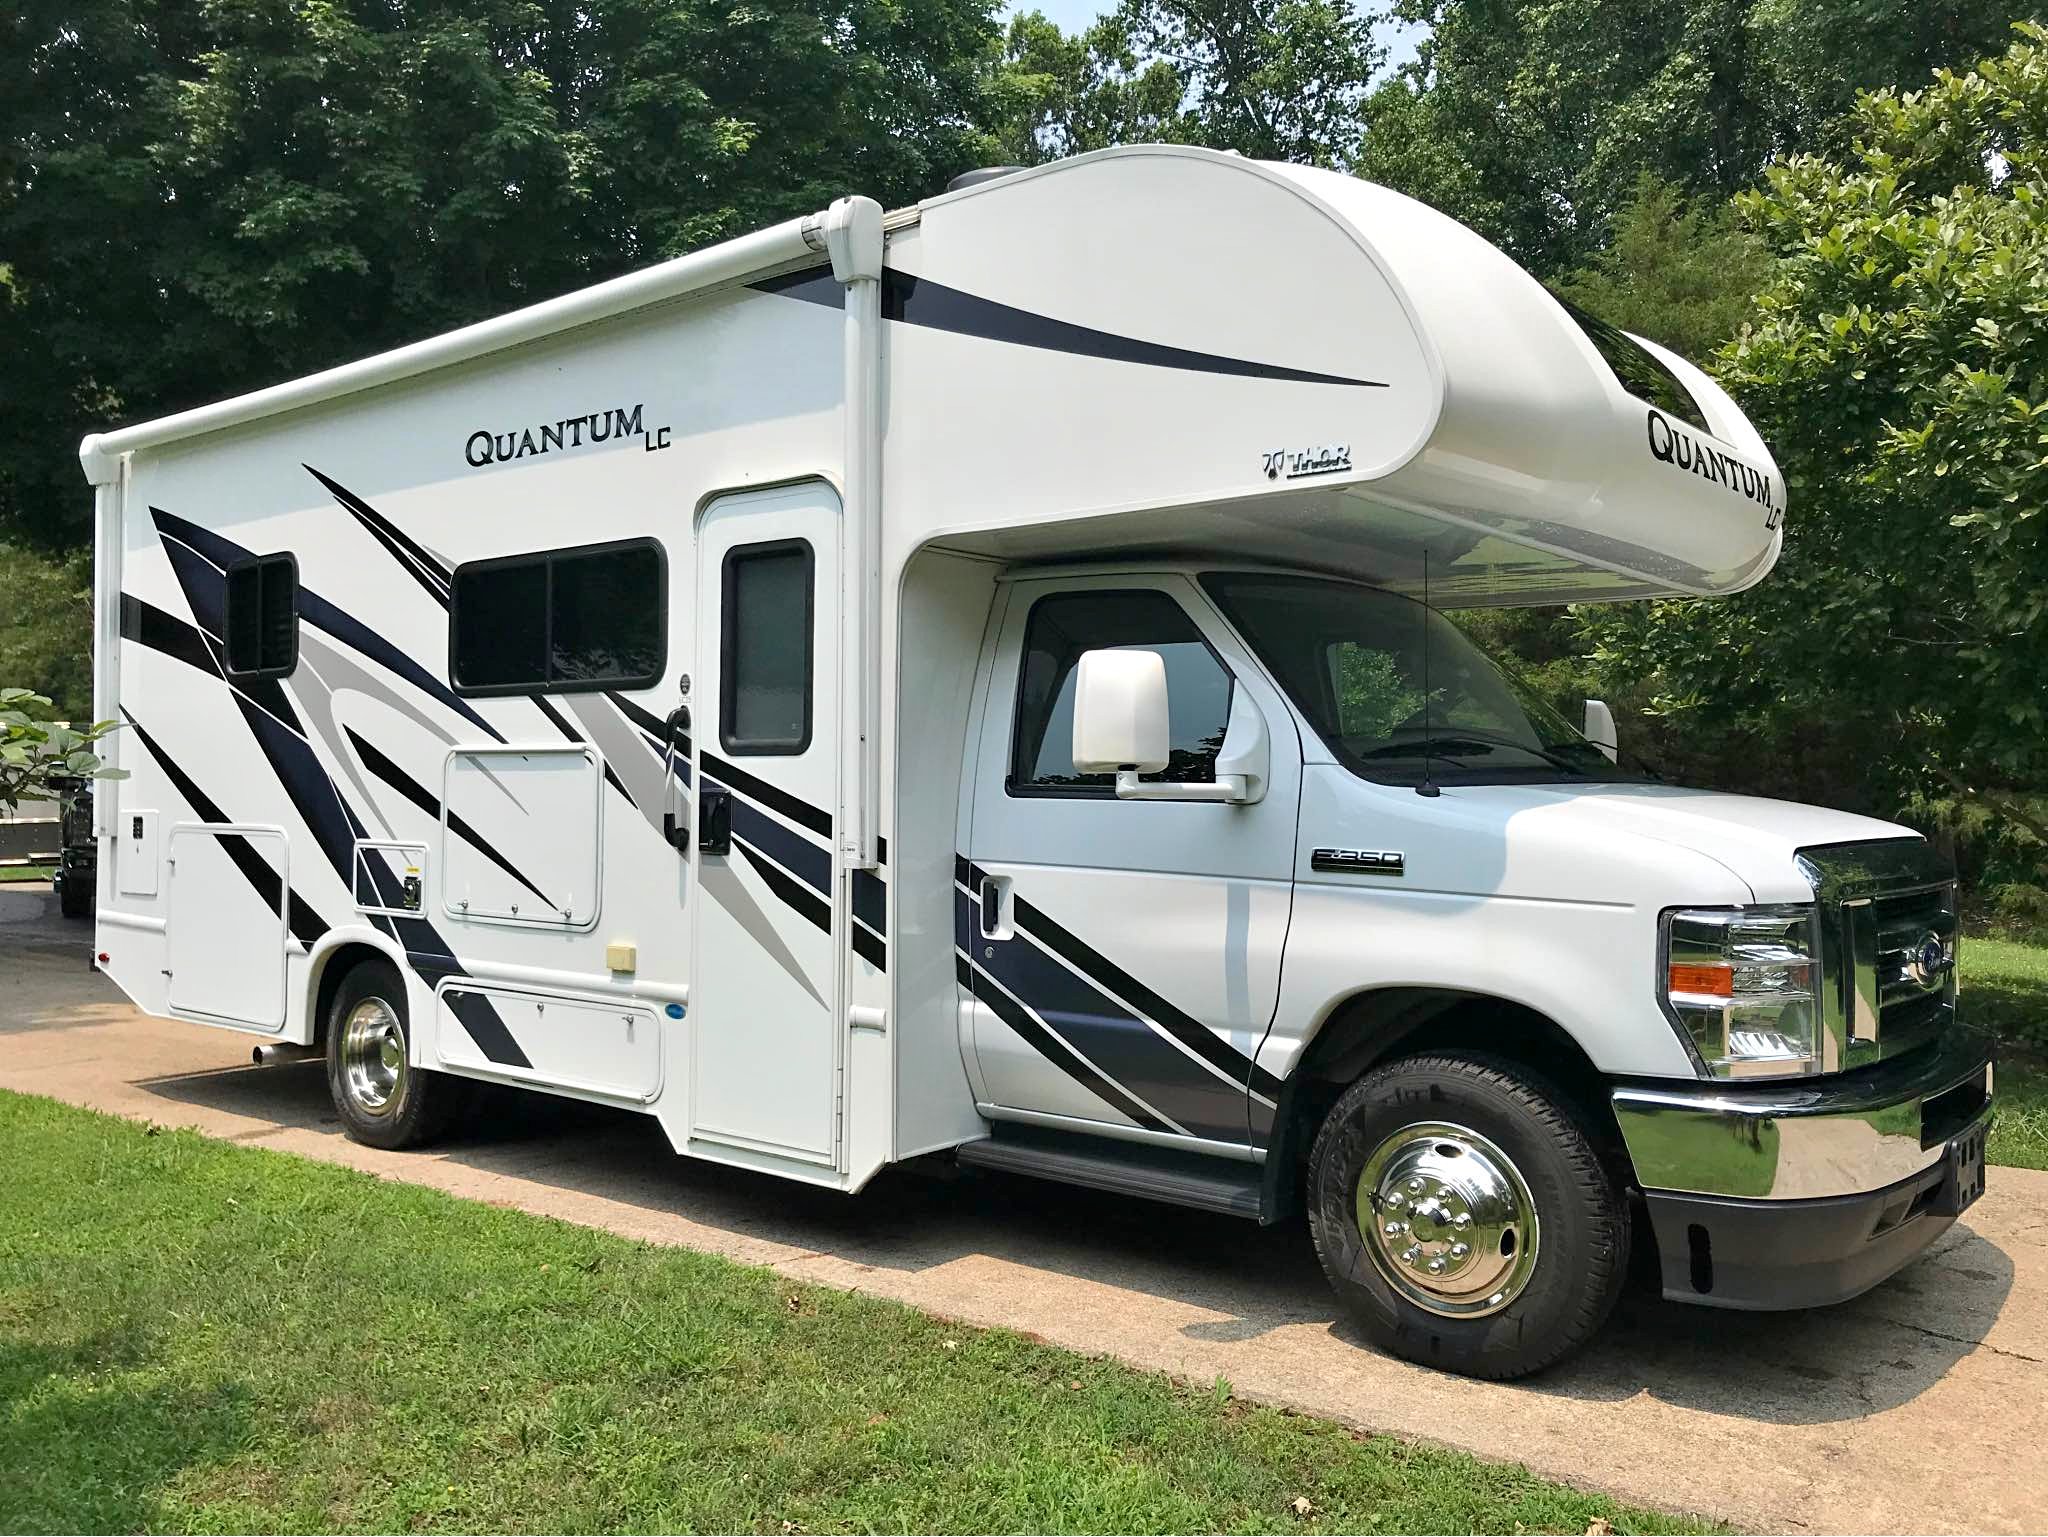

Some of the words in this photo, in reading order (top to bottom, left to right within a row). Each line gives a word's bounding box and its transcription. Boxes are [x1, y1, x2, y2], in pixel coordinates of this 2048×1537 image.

[465, 404, 644, 467] QUANTUM
[645, 427, 671, 452] LC
[1286, 445, 1352, 475] THOR
[1647, 409, 1771, 509] QUANTUM
